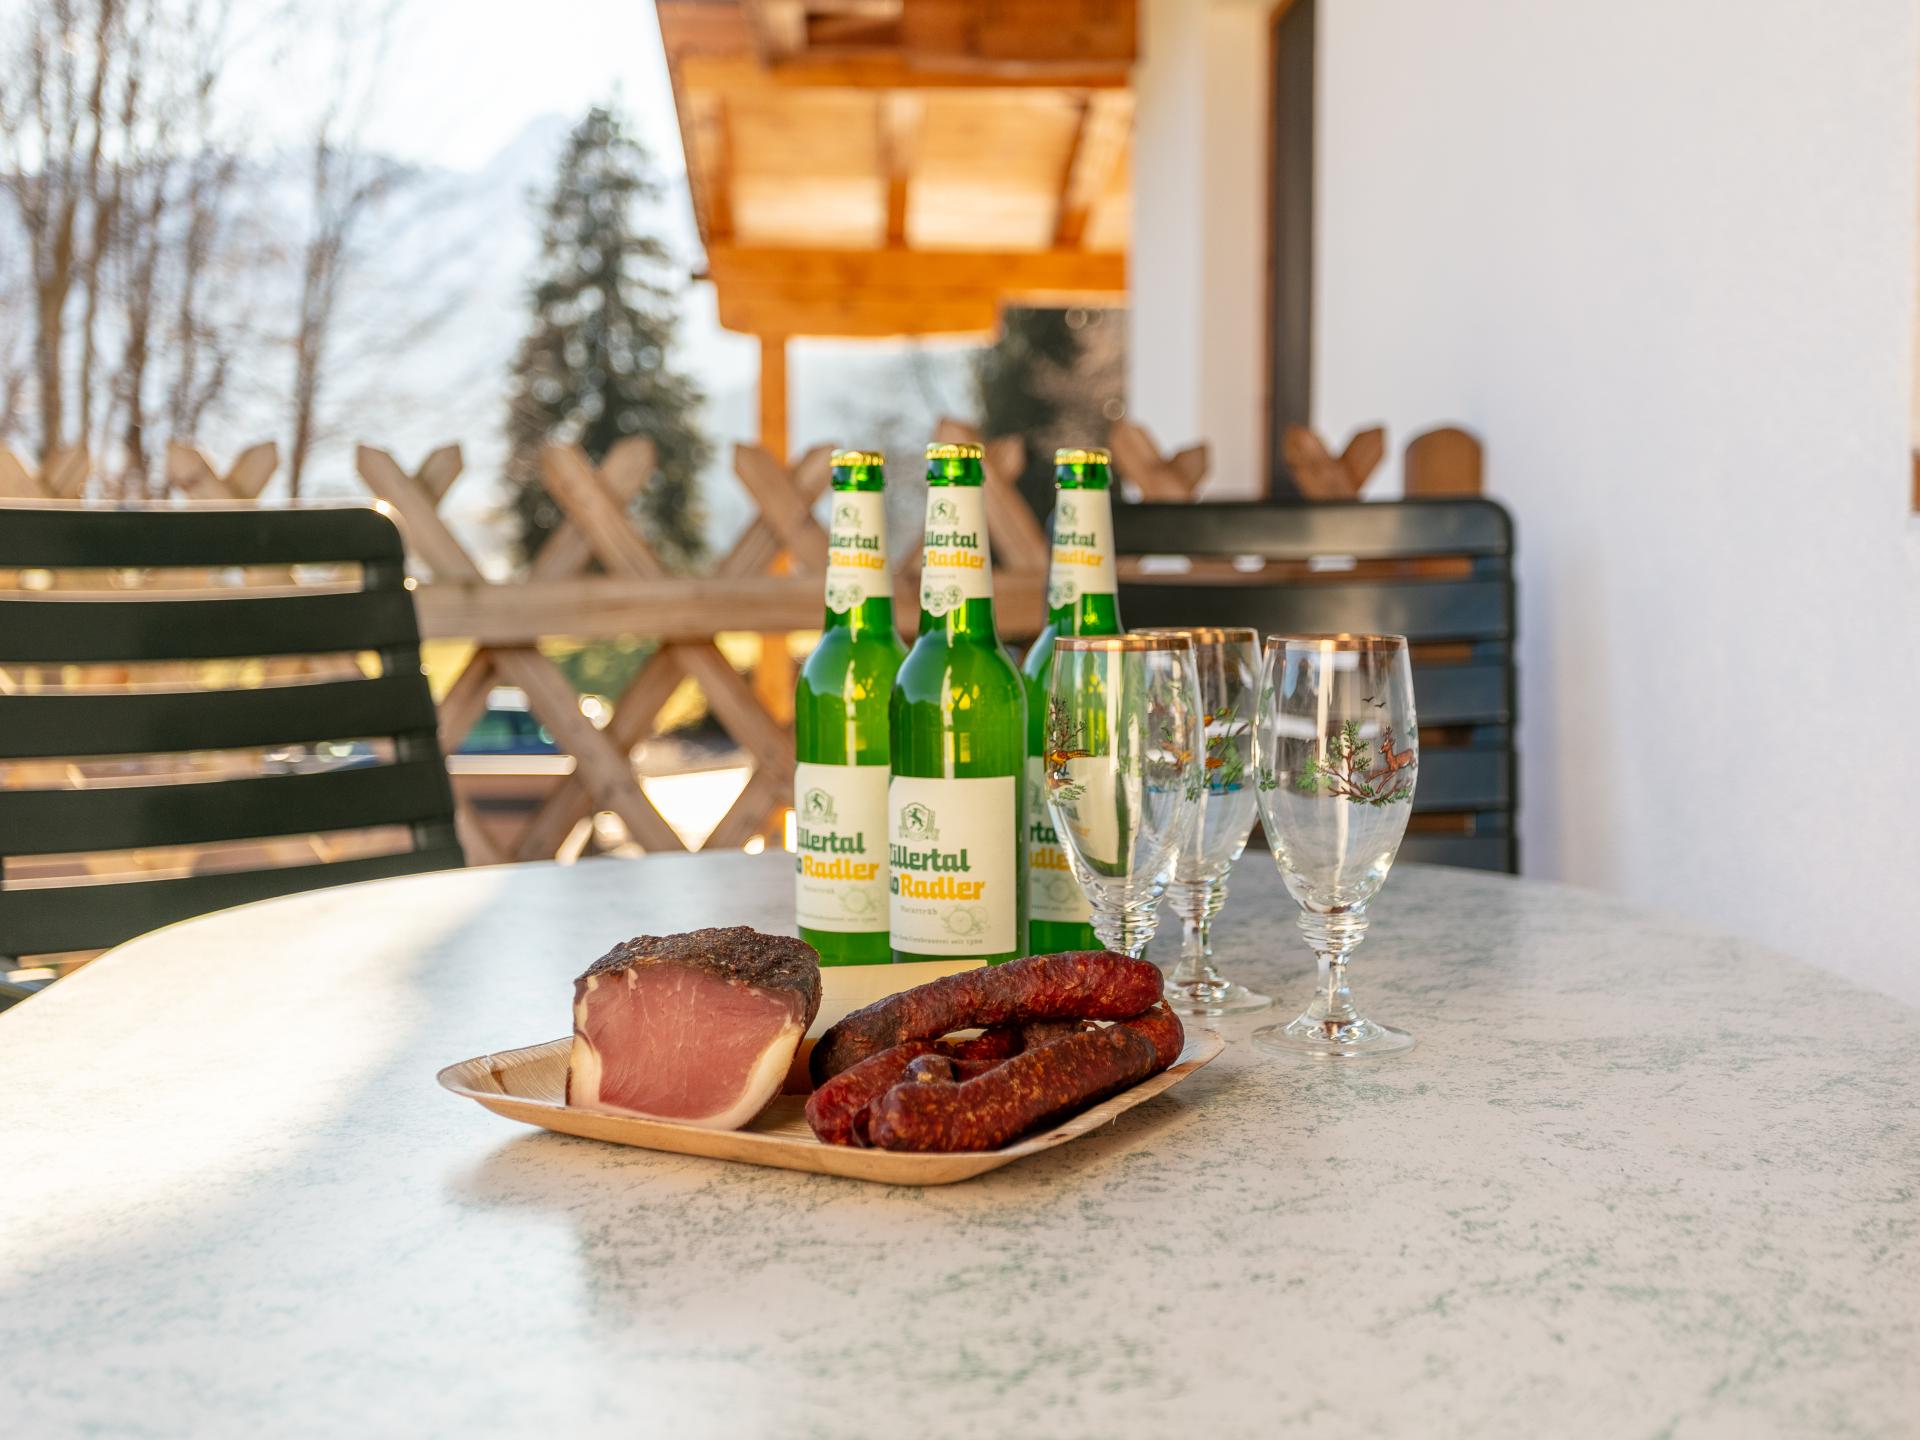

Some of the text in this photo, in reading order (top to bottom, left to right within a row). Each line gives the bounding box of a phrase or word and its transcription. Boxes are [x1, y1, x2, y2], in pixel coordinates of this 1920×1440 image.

[832, 551, 885, 570] Radler
[928, 550, 986, 570] Radler
[803, 854, 880, 880] Radler
[900, 873, 986, 900] Radler
